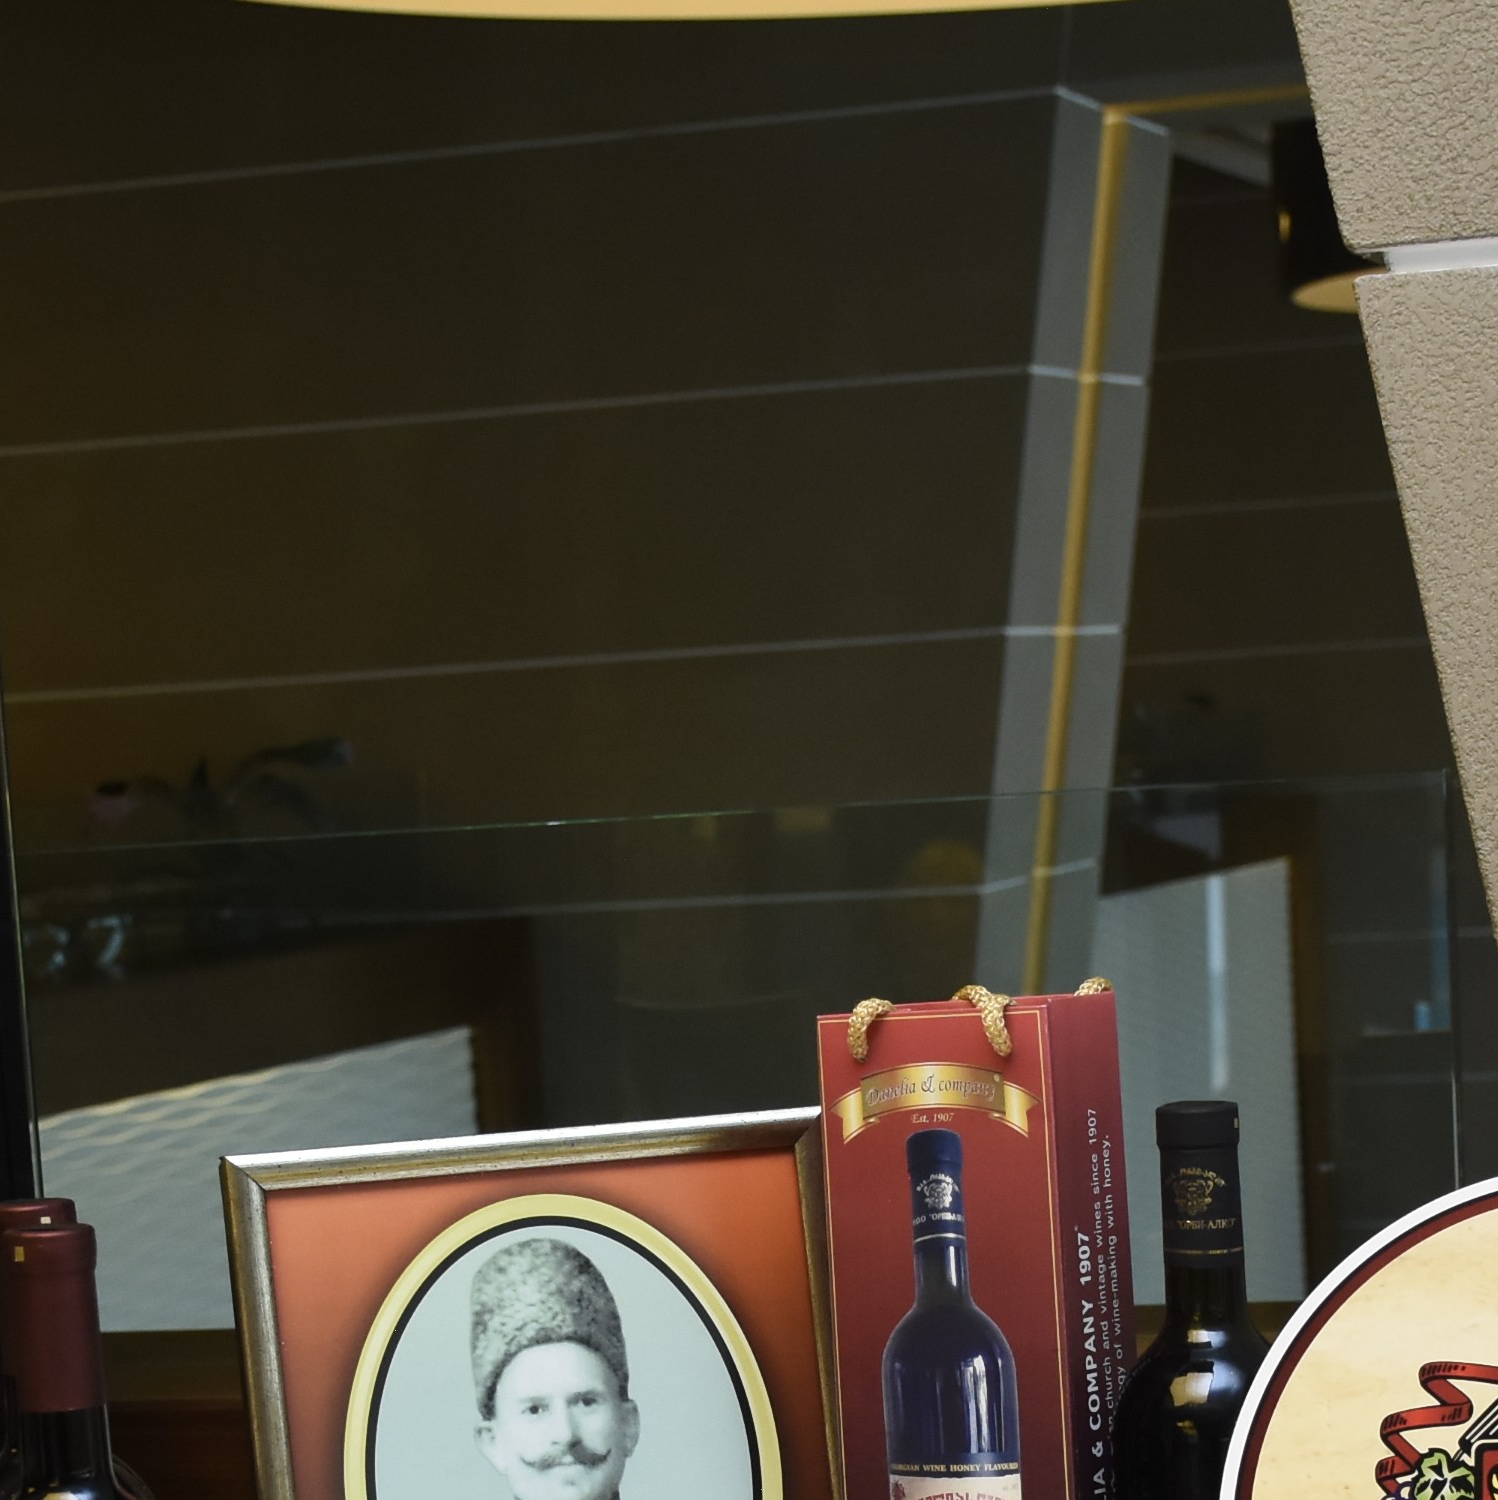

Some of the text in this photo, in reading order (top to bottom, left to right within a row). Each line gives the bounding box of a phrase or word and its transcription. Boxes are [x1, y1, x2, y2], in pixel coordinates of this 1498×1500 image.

[867, 1075, 996, 1106] Danelia & company
[911, 1113, 954, 1123] Est. 1907
[1087, 1108, 1098, 1145] 1907
[1089, 1154, 1100, 1194] since
[1092, 1202, 1104, 1247] wines
[1103, 1193, 1115, 1229] with
[1077, 1233, 1092, 1285] 1907
[1096, 1254, 1110, 1314] vintage
[1099, 1321, 1110, 1349] and
[1081, 1299, 1102, 1430] COMPANY
[1092, 1440, 1103, 1457] &
[923, 1464, 982, 1472] WINE HONEY
